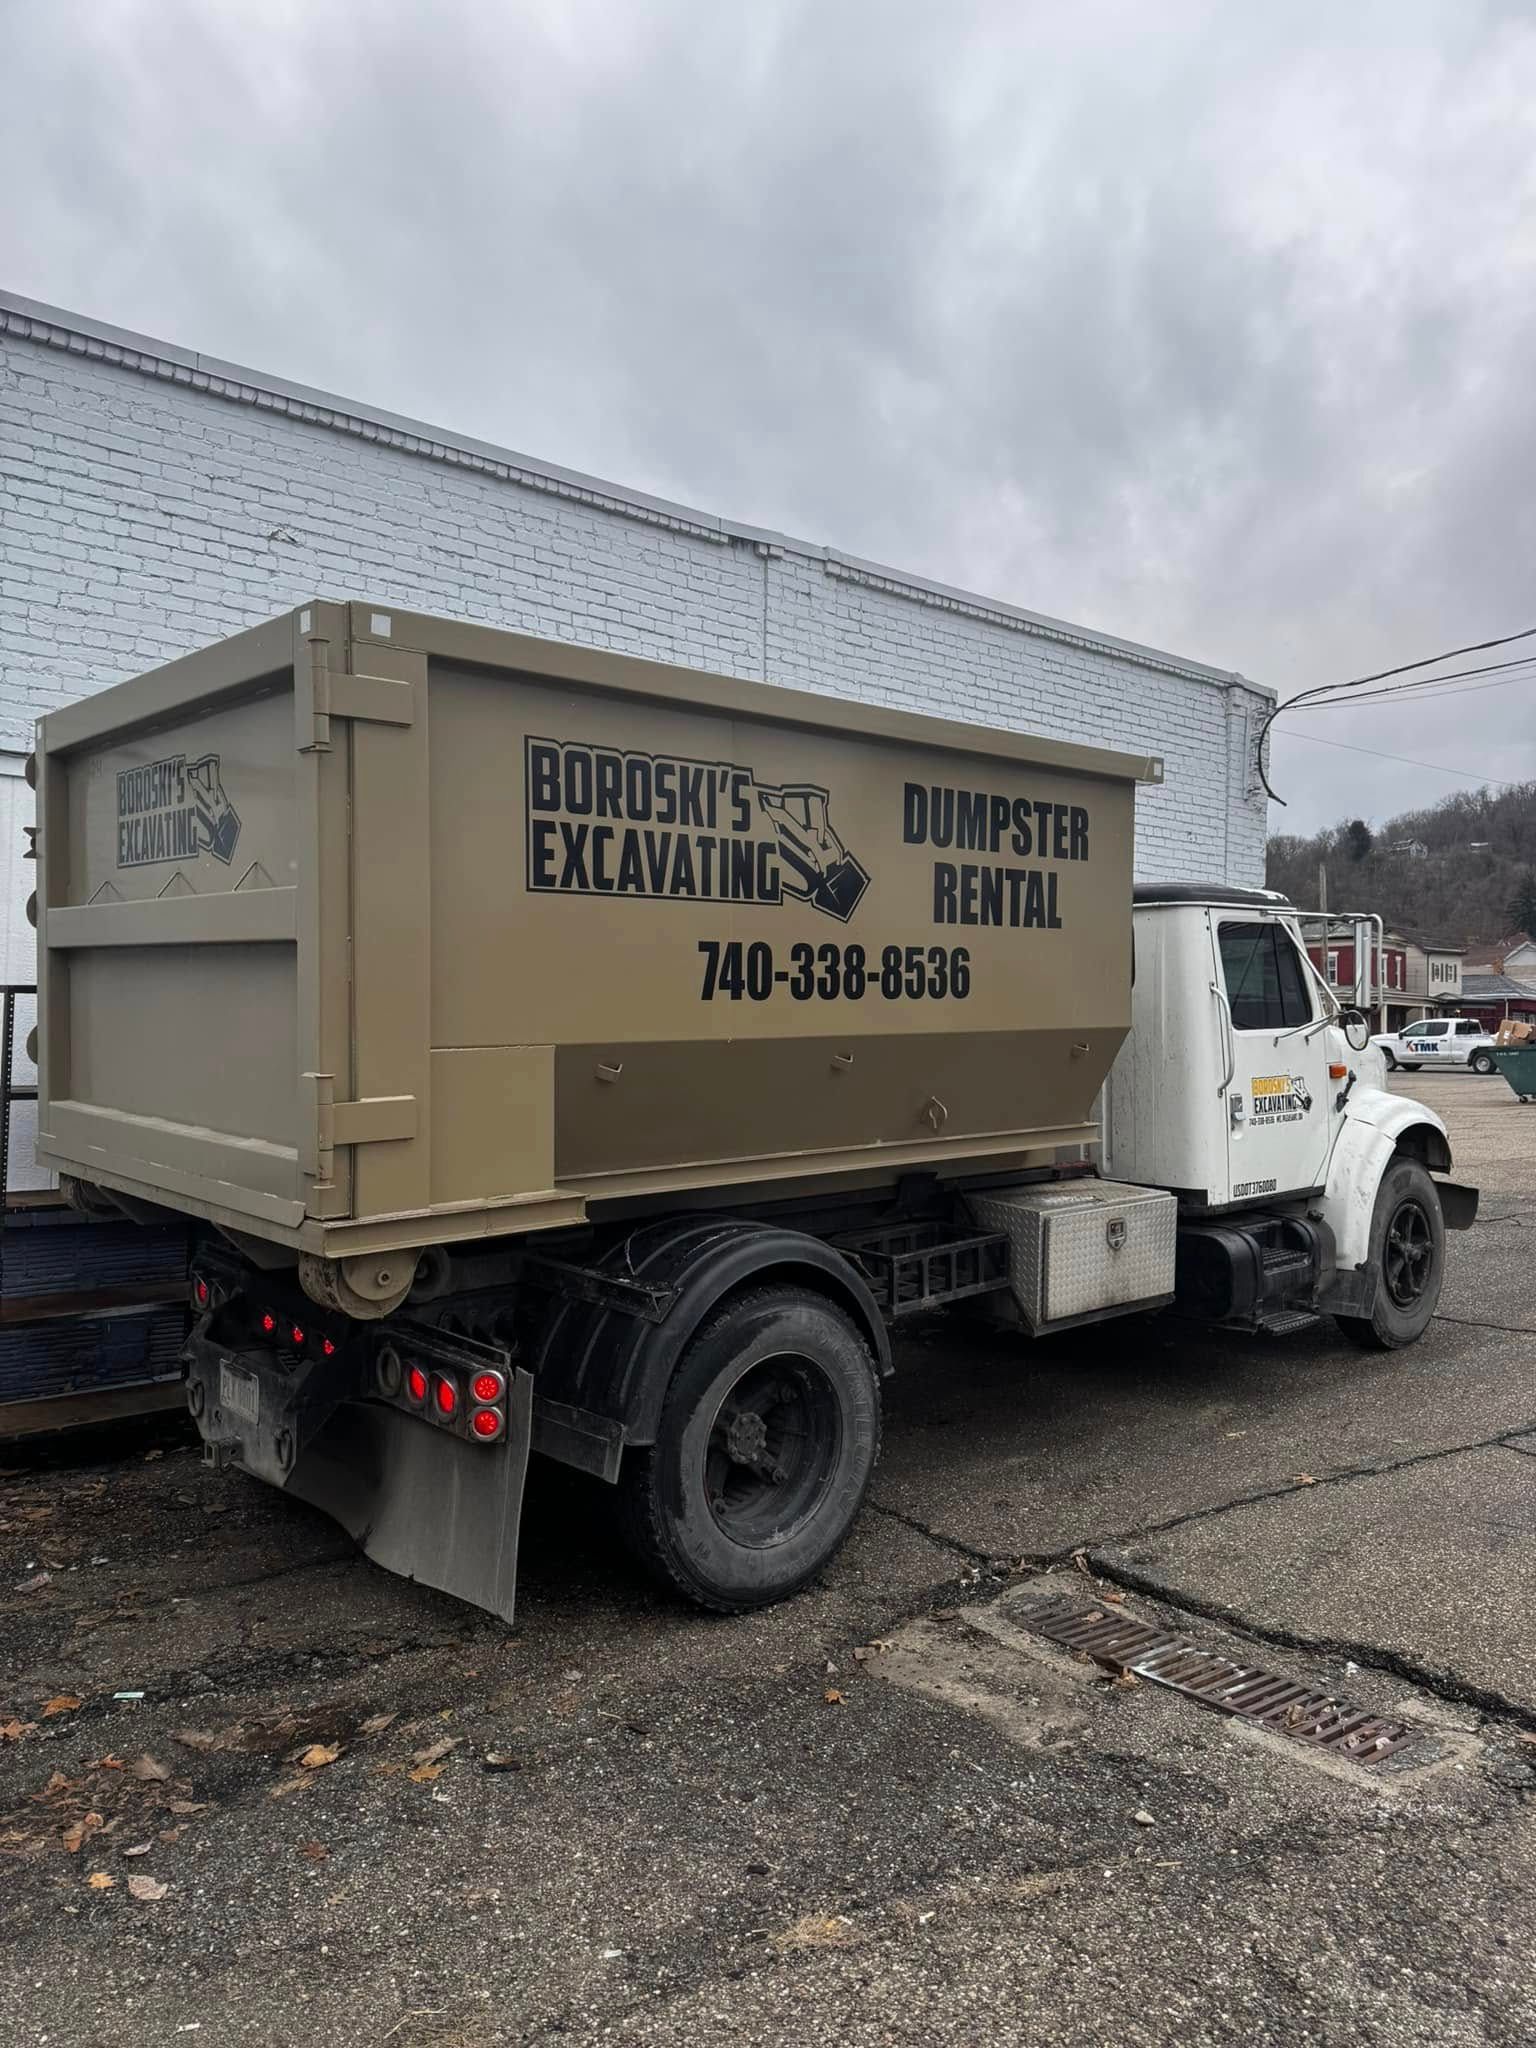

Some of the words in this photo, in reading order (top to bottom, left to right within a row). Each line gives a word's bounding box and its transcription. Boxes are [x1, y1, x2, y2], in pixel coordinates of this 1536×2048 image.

[118, 759, 185, 817] BOROSKI'S
[531, 745, 750, 832] BOROSKI'S
[119, 807, 198, 864] EXCAVATING
[903, 783, 1089, 861] DUMPSTER
[531, 820, 779, 901] EXCAVATING
[933, 862, 1062, 929] RENTAL
[698, 941, 971, 1001] 740-338-8536
[1254, 1094, 1297, 1114] EXCAVATING
